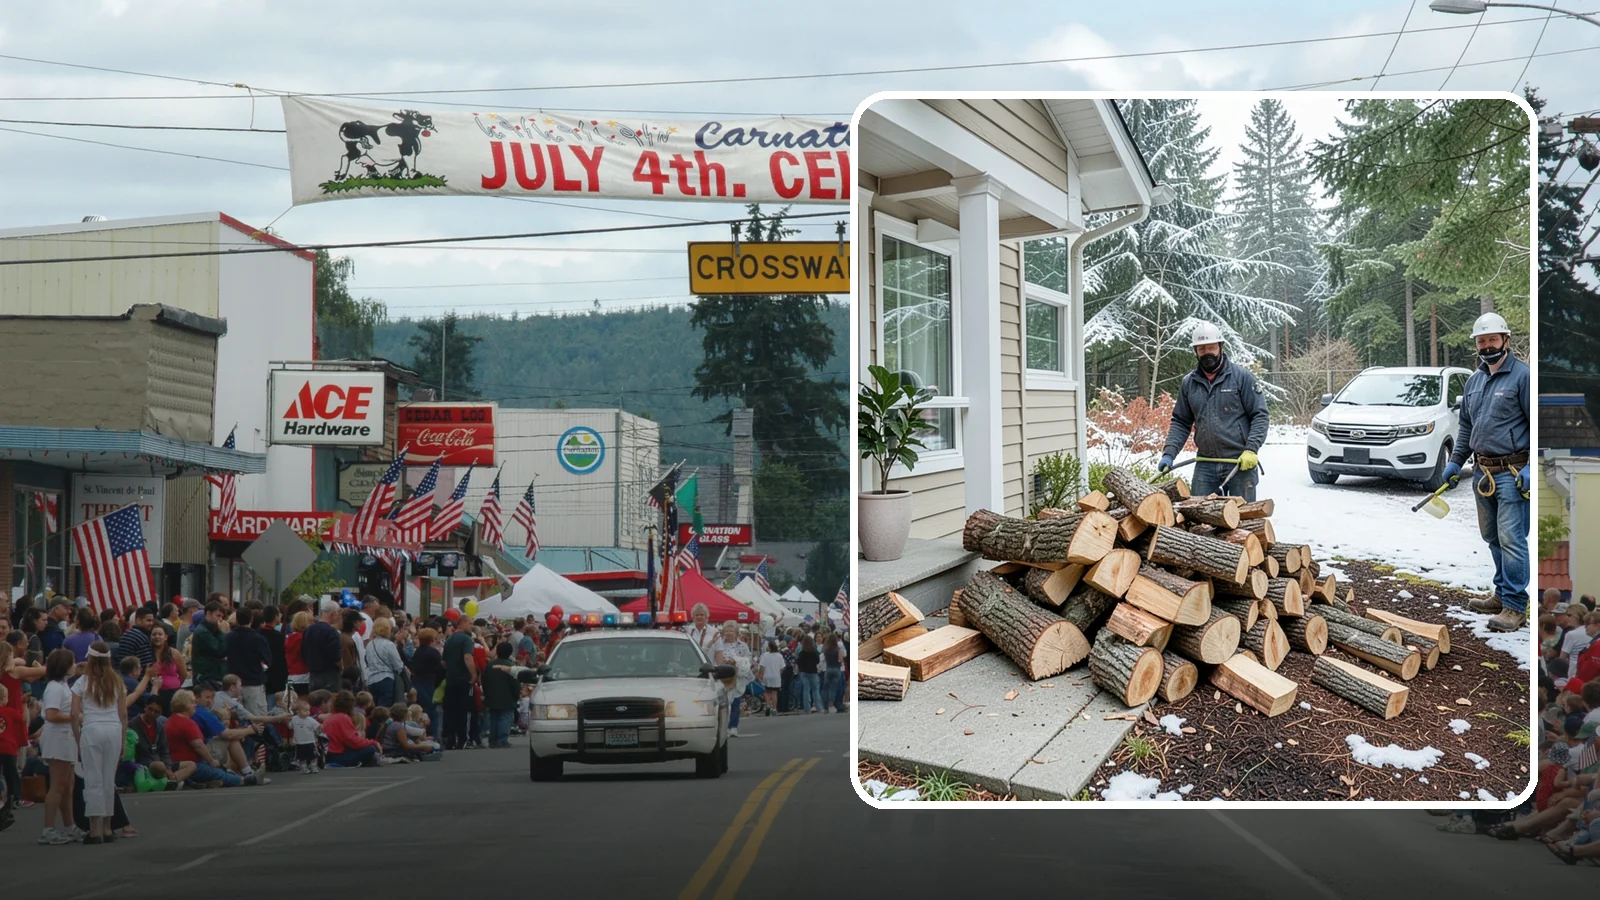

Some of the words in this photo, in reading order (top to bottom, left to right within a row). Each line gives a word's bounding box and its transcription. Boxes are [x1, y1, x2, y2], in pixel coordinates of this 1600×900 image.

[481, 141, 604, 193] JULY
[632, 150, 746, 198] 4th.
[696, 254, 850, 280] CROSSWA
[283, 380, 373, 420] ACE
[406, 409, 452, 422] CEDAR
[284, 421, 371, 437] Hardware
[95, 485, 124, 494] Vincent
[126, 486, 136, 494] de
[137, 486, 155, 495] Paul
[688, 526, 741, 535] CRNATION
[699, 535, 730, 543] GLASS
